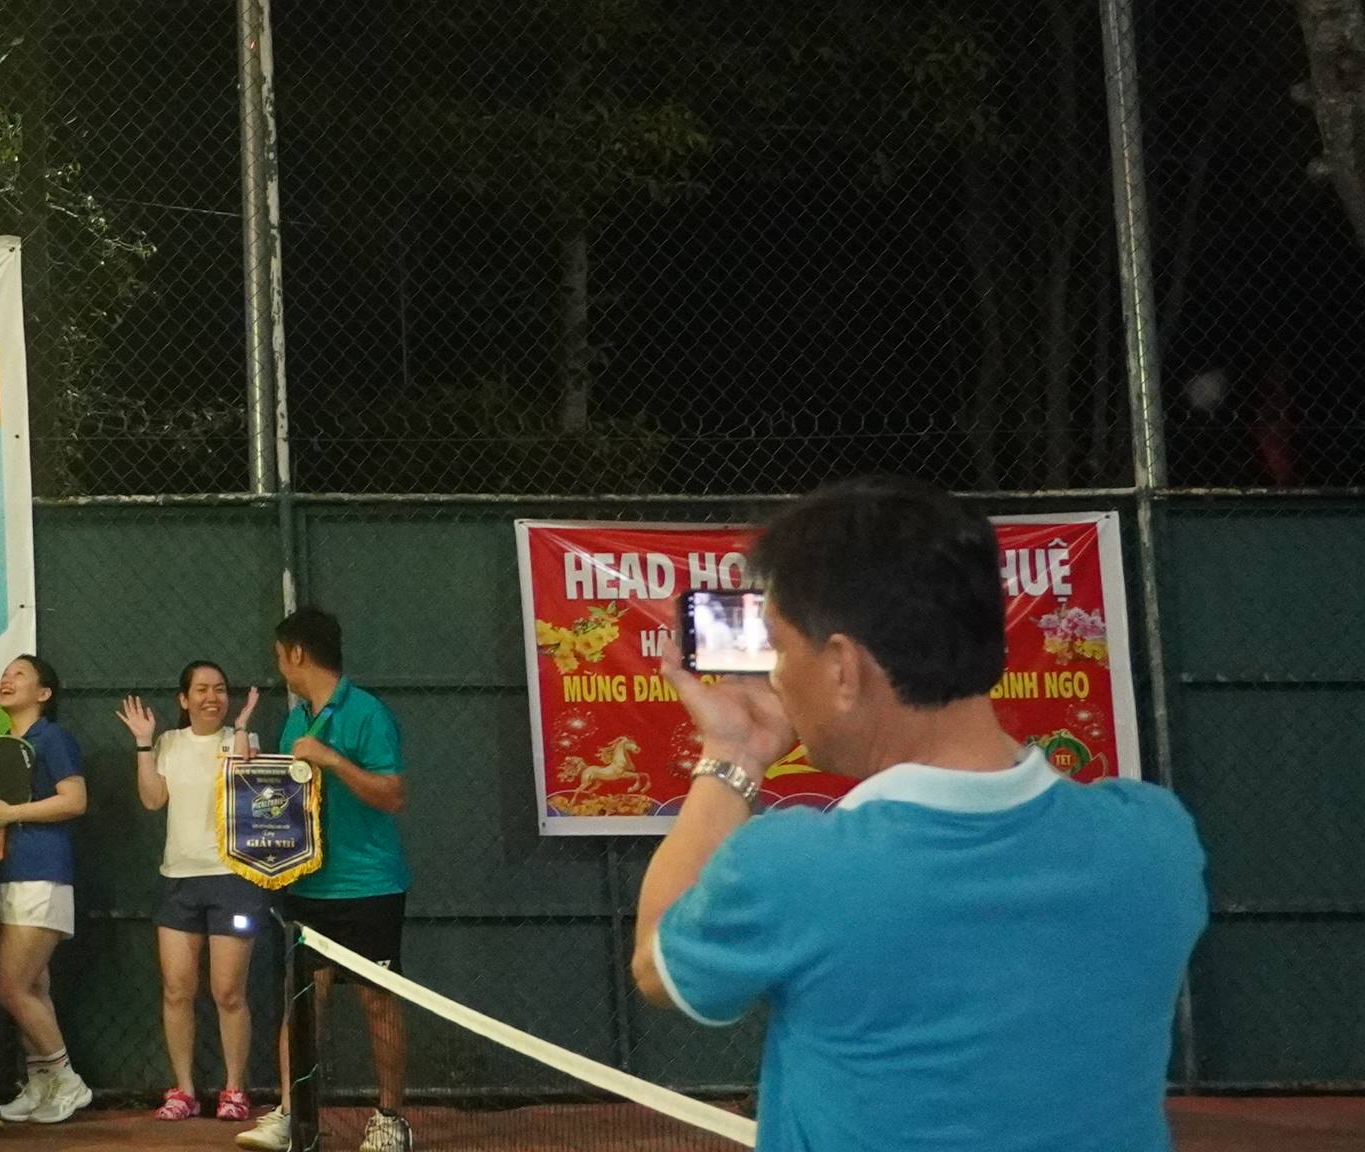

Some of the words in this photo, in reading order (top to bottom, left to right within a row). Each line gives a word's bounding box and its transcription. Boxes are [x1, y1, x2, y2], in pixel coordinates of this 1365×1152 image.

[564, 552, 676, 600] HEAD
[687, 552, 759, 591] HO
[563, 670, 627, 703] MỪNG
[633, 668, 679, 703] ĐẢN
